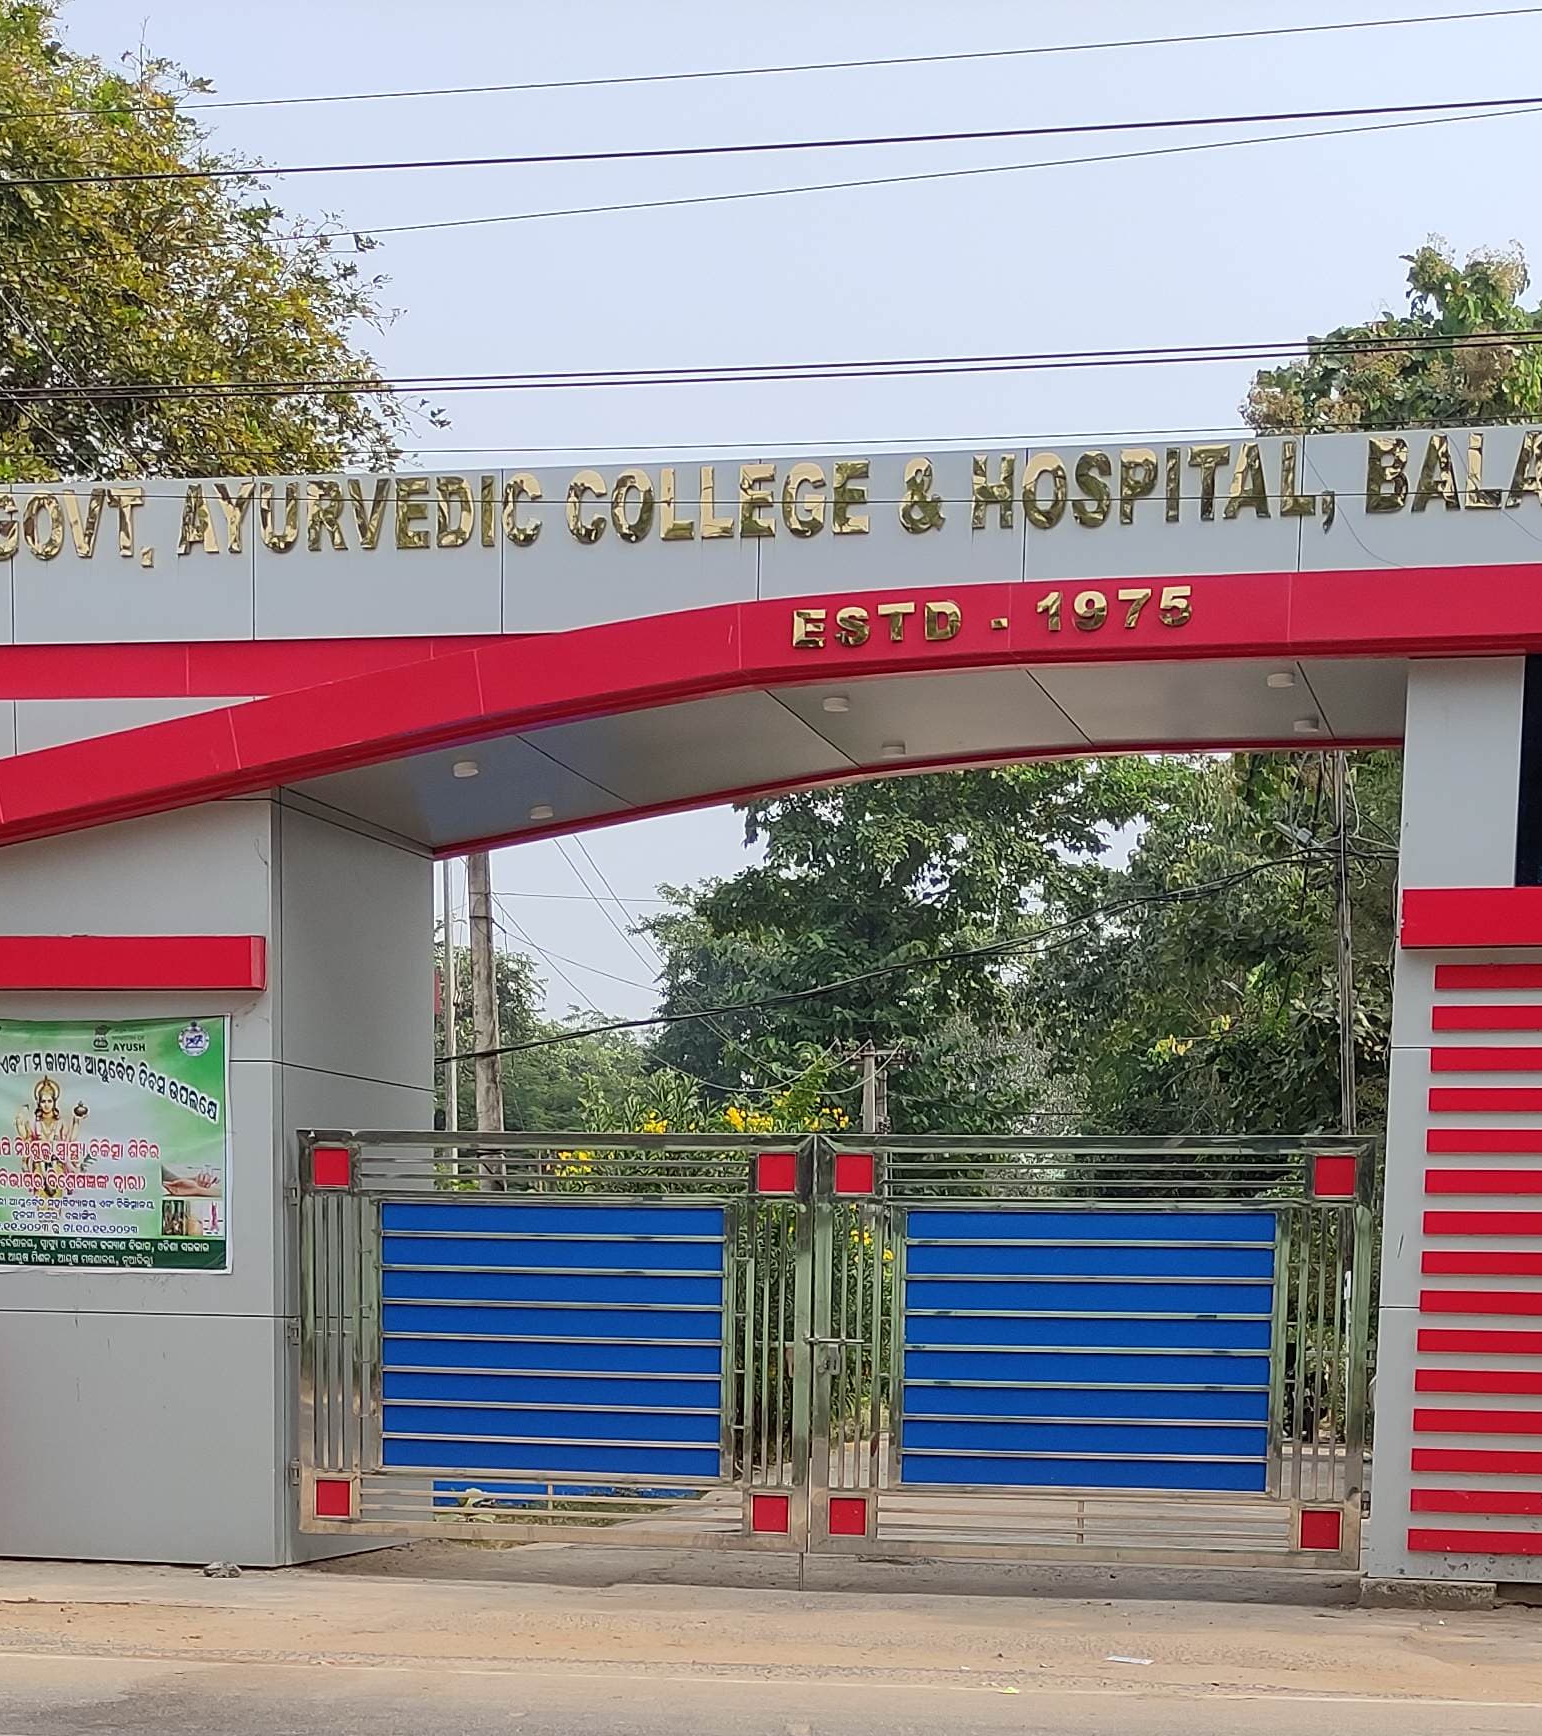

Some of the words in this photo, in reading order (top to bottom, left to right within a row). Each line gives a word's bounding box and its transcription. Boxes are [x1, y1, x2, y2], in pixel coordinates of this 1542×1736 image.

[176, 472, 543, 555] AYURVEDIC
[566, 459, 870, 545] COLLEGE
[897, 457, 946, 534] &
[971, 440, 1336, 534] HOSPITAL,
[792, 600, 962, 649] ESTD
[1036, 585, 1193, 632] 1975
[113, 1043, 146, 1052] AYUSH
